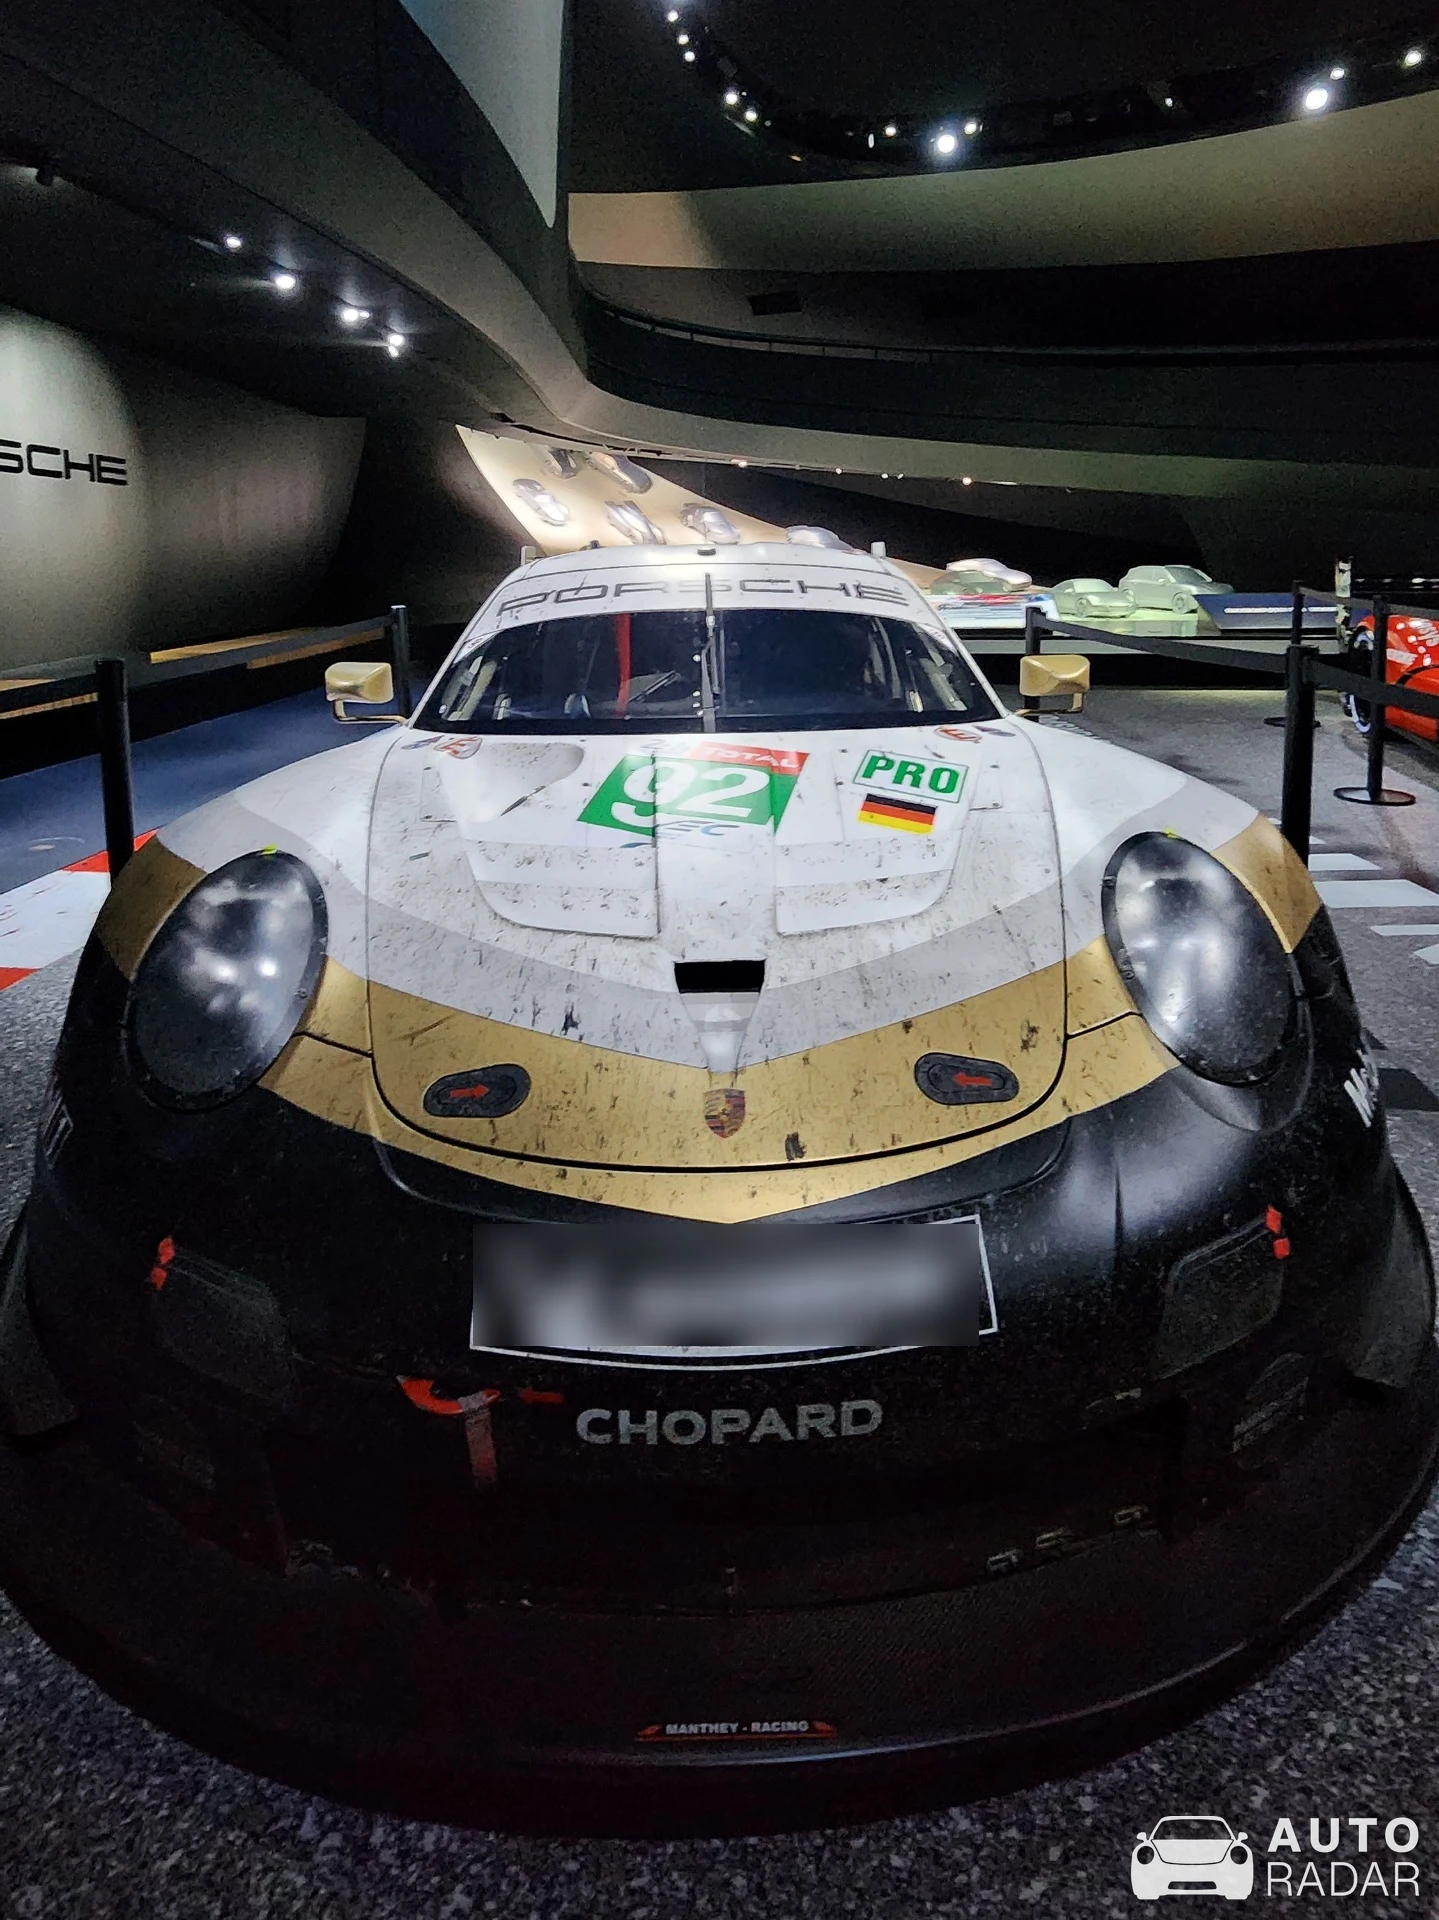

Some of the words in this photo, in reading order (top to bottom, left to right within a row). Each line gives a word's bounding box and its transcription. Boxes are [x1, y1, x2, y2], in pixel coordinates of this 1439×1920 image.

[498, 578, 909, 617] PORSCHE
[704, 746, 799, 769] TOTAL
[861, 754, 961, 794] PRO
[610, 760, 771, 828] 92
[576, 1399, 884, 1446] CHOPARD
[665, 1722, 739, 1735] MANTHEY
[751, 1720, 810, 1733] RACING
